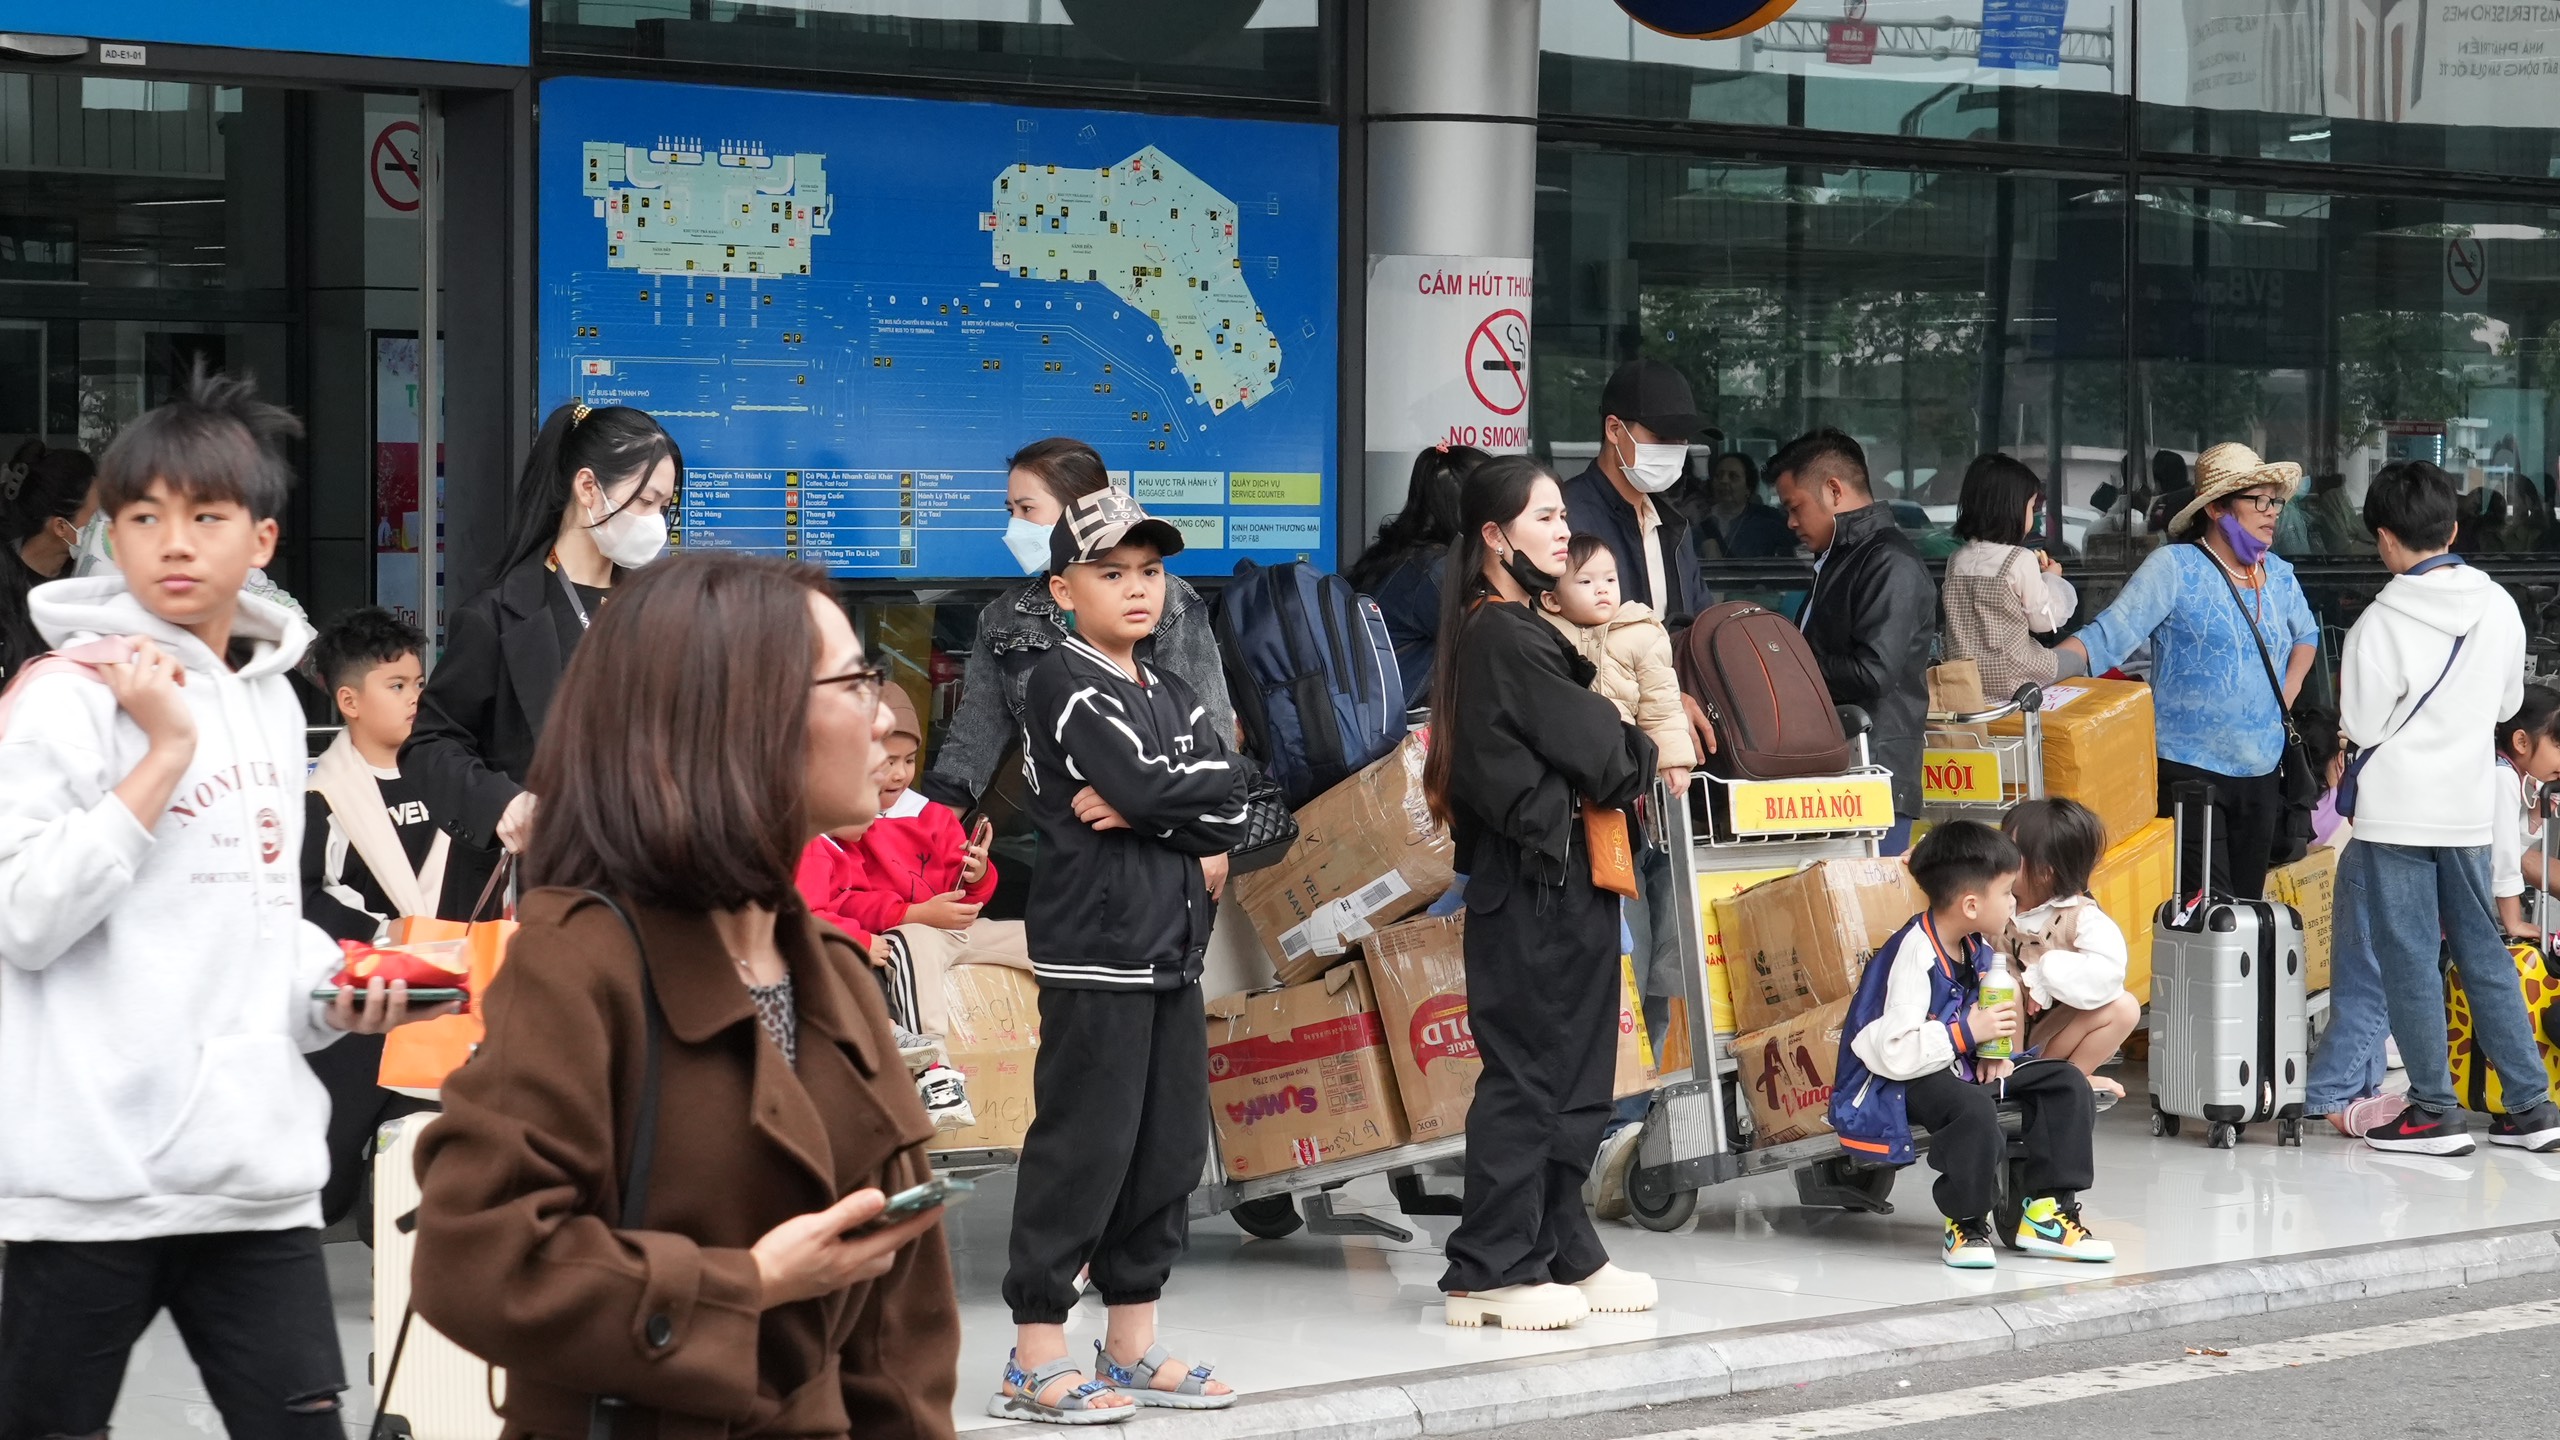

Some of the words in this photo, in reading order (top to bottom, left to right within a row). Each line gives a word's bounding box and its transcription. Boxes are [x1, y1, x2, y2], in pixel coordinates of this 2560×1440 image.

[105, 50, 141, 60] AD-E1-01
[1418, 269, 1462, 295] CẤM
[1469, 270, 1503, 297] HÚT
[1450, 426, 1476, 446] NO
[1155, 479, 1171, 487] VỰC
[1173, 477, 1186, 486] TRẢ
[1188, 477, 1207, 486] HÀNH
[1209, 477, 1217, 486] LÝ
[1231, 478, 1251, 488] QUẦY
[1253, 479, 1269, 489] DỊCH
[1271, 480, 1280, 489] VỤ
[1173, 517, 1193, 528] CÔNG
[1195, 518, 1215, 529] CỘNG
[1276, 523, 1306, 532] THƯƠNG
[1307, 524, 1319, 533] MẠI
[1231, 534, 1247, 542] SHOP,
[1925, 758, 1974, 796] NỘI
[1765, 797, 1798, 819] BIA
[1801, 789, 1828, 819] HÀ
[1831, 788, 1863, 822] NỘI
[2297, 871, 2329, 888] MEASUREME
[1302, 875, 1325, 909] YELL
[1423, 1015, 1472, 1045] OLD
[1446, 1040, 1475, 1055] ARIE
[1253, 1074, 1267, 1085] 275g
[1417, 1118, 1439, 1131] BOX
